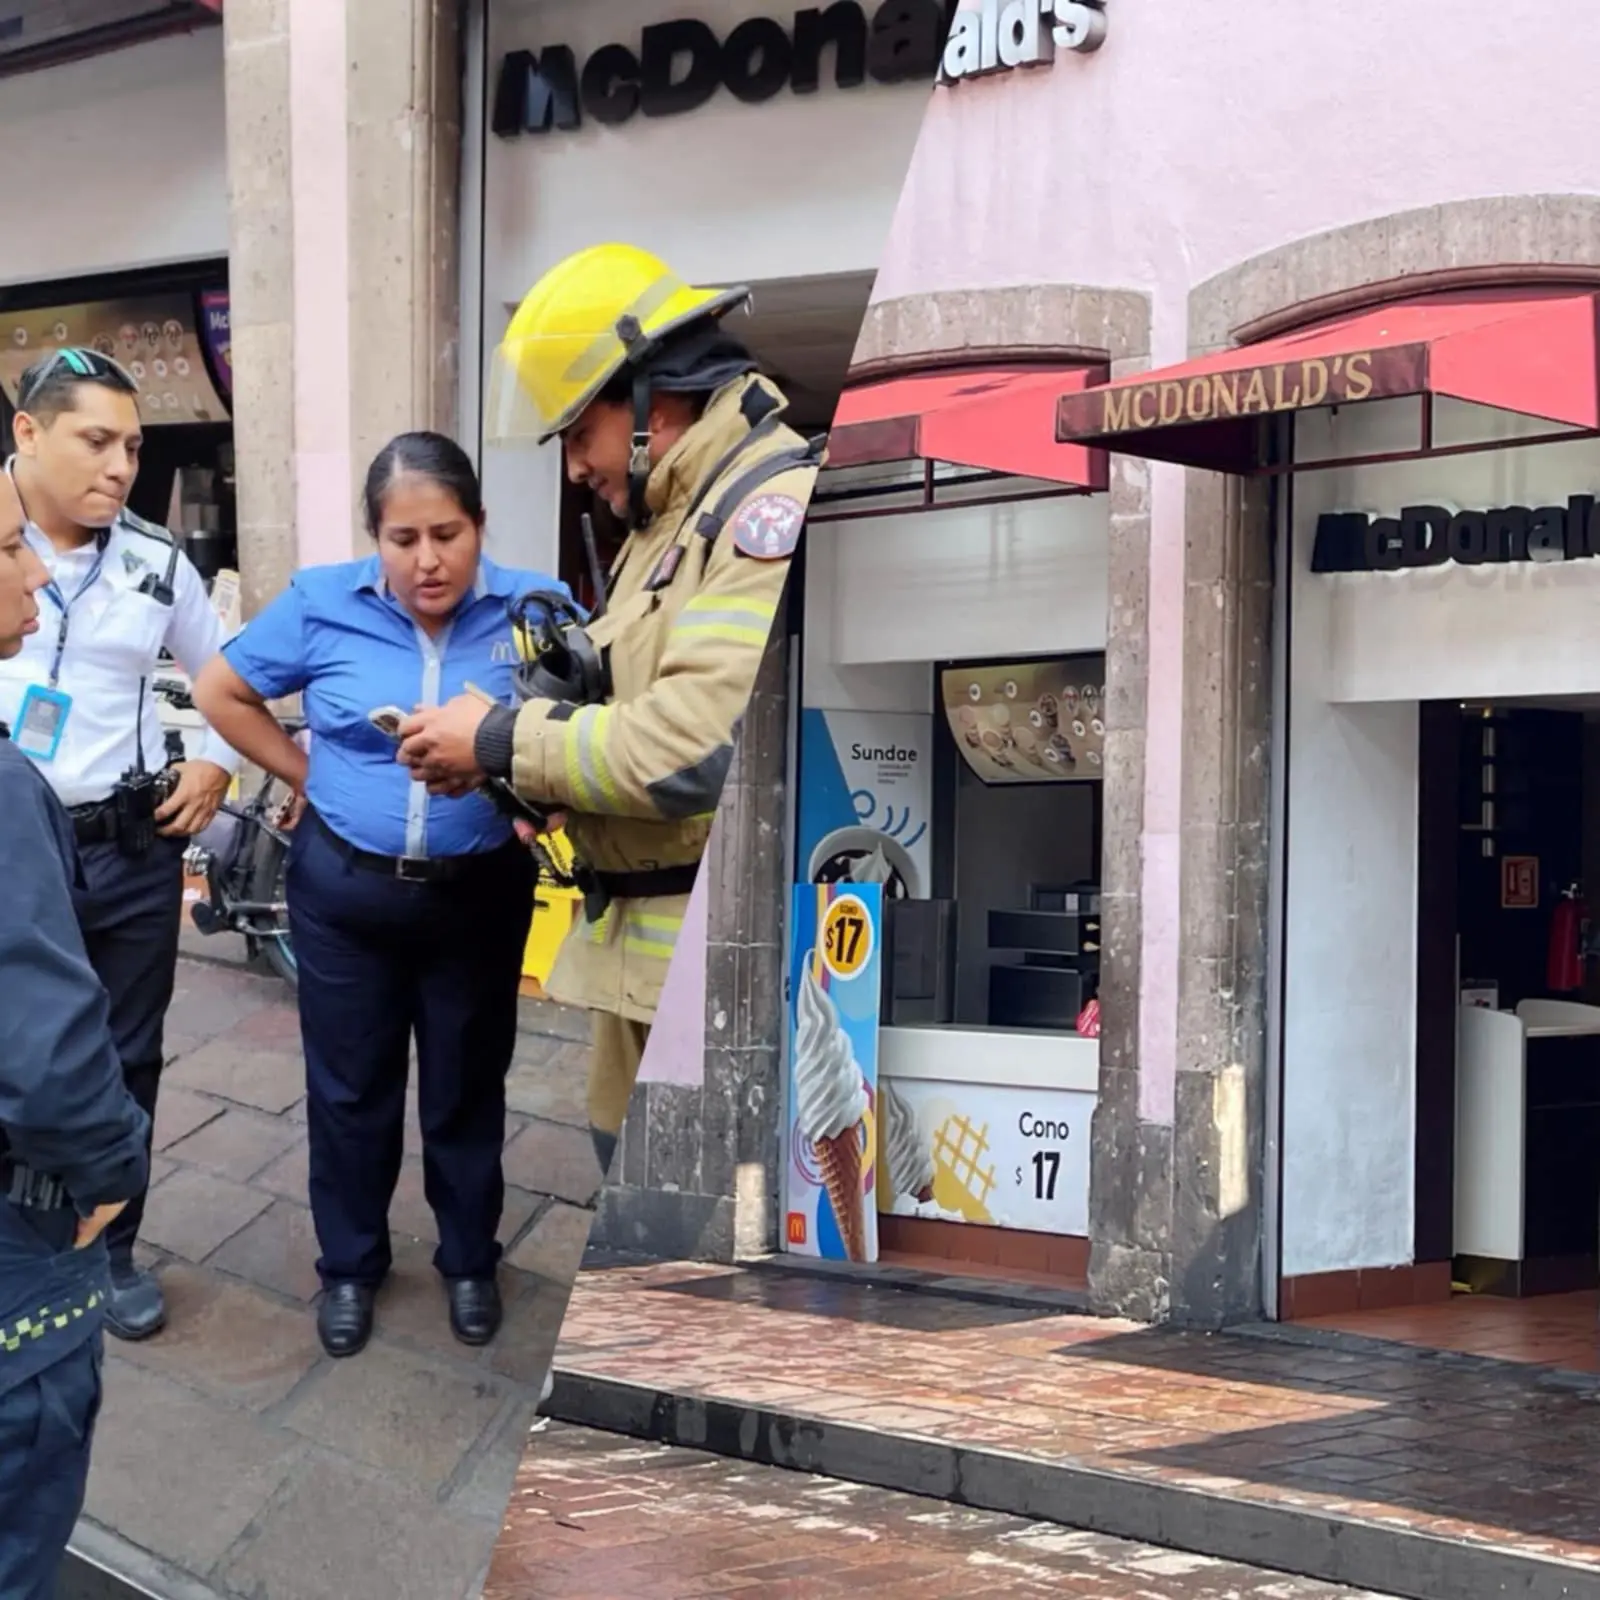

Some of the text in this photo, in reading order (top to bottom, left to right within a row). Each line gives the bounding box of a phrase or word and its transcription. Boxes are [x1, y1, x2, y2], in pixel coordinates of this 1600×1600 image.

[1101, 352, 1374, 433] MCDONALD'S
[1310, 493, 1600, 573] McDonal
[851, 743, 918, 762] Sundae
[1019, 1111, 1070, 1141] Cono
[1031, 1150, 1061, 1201] 17
